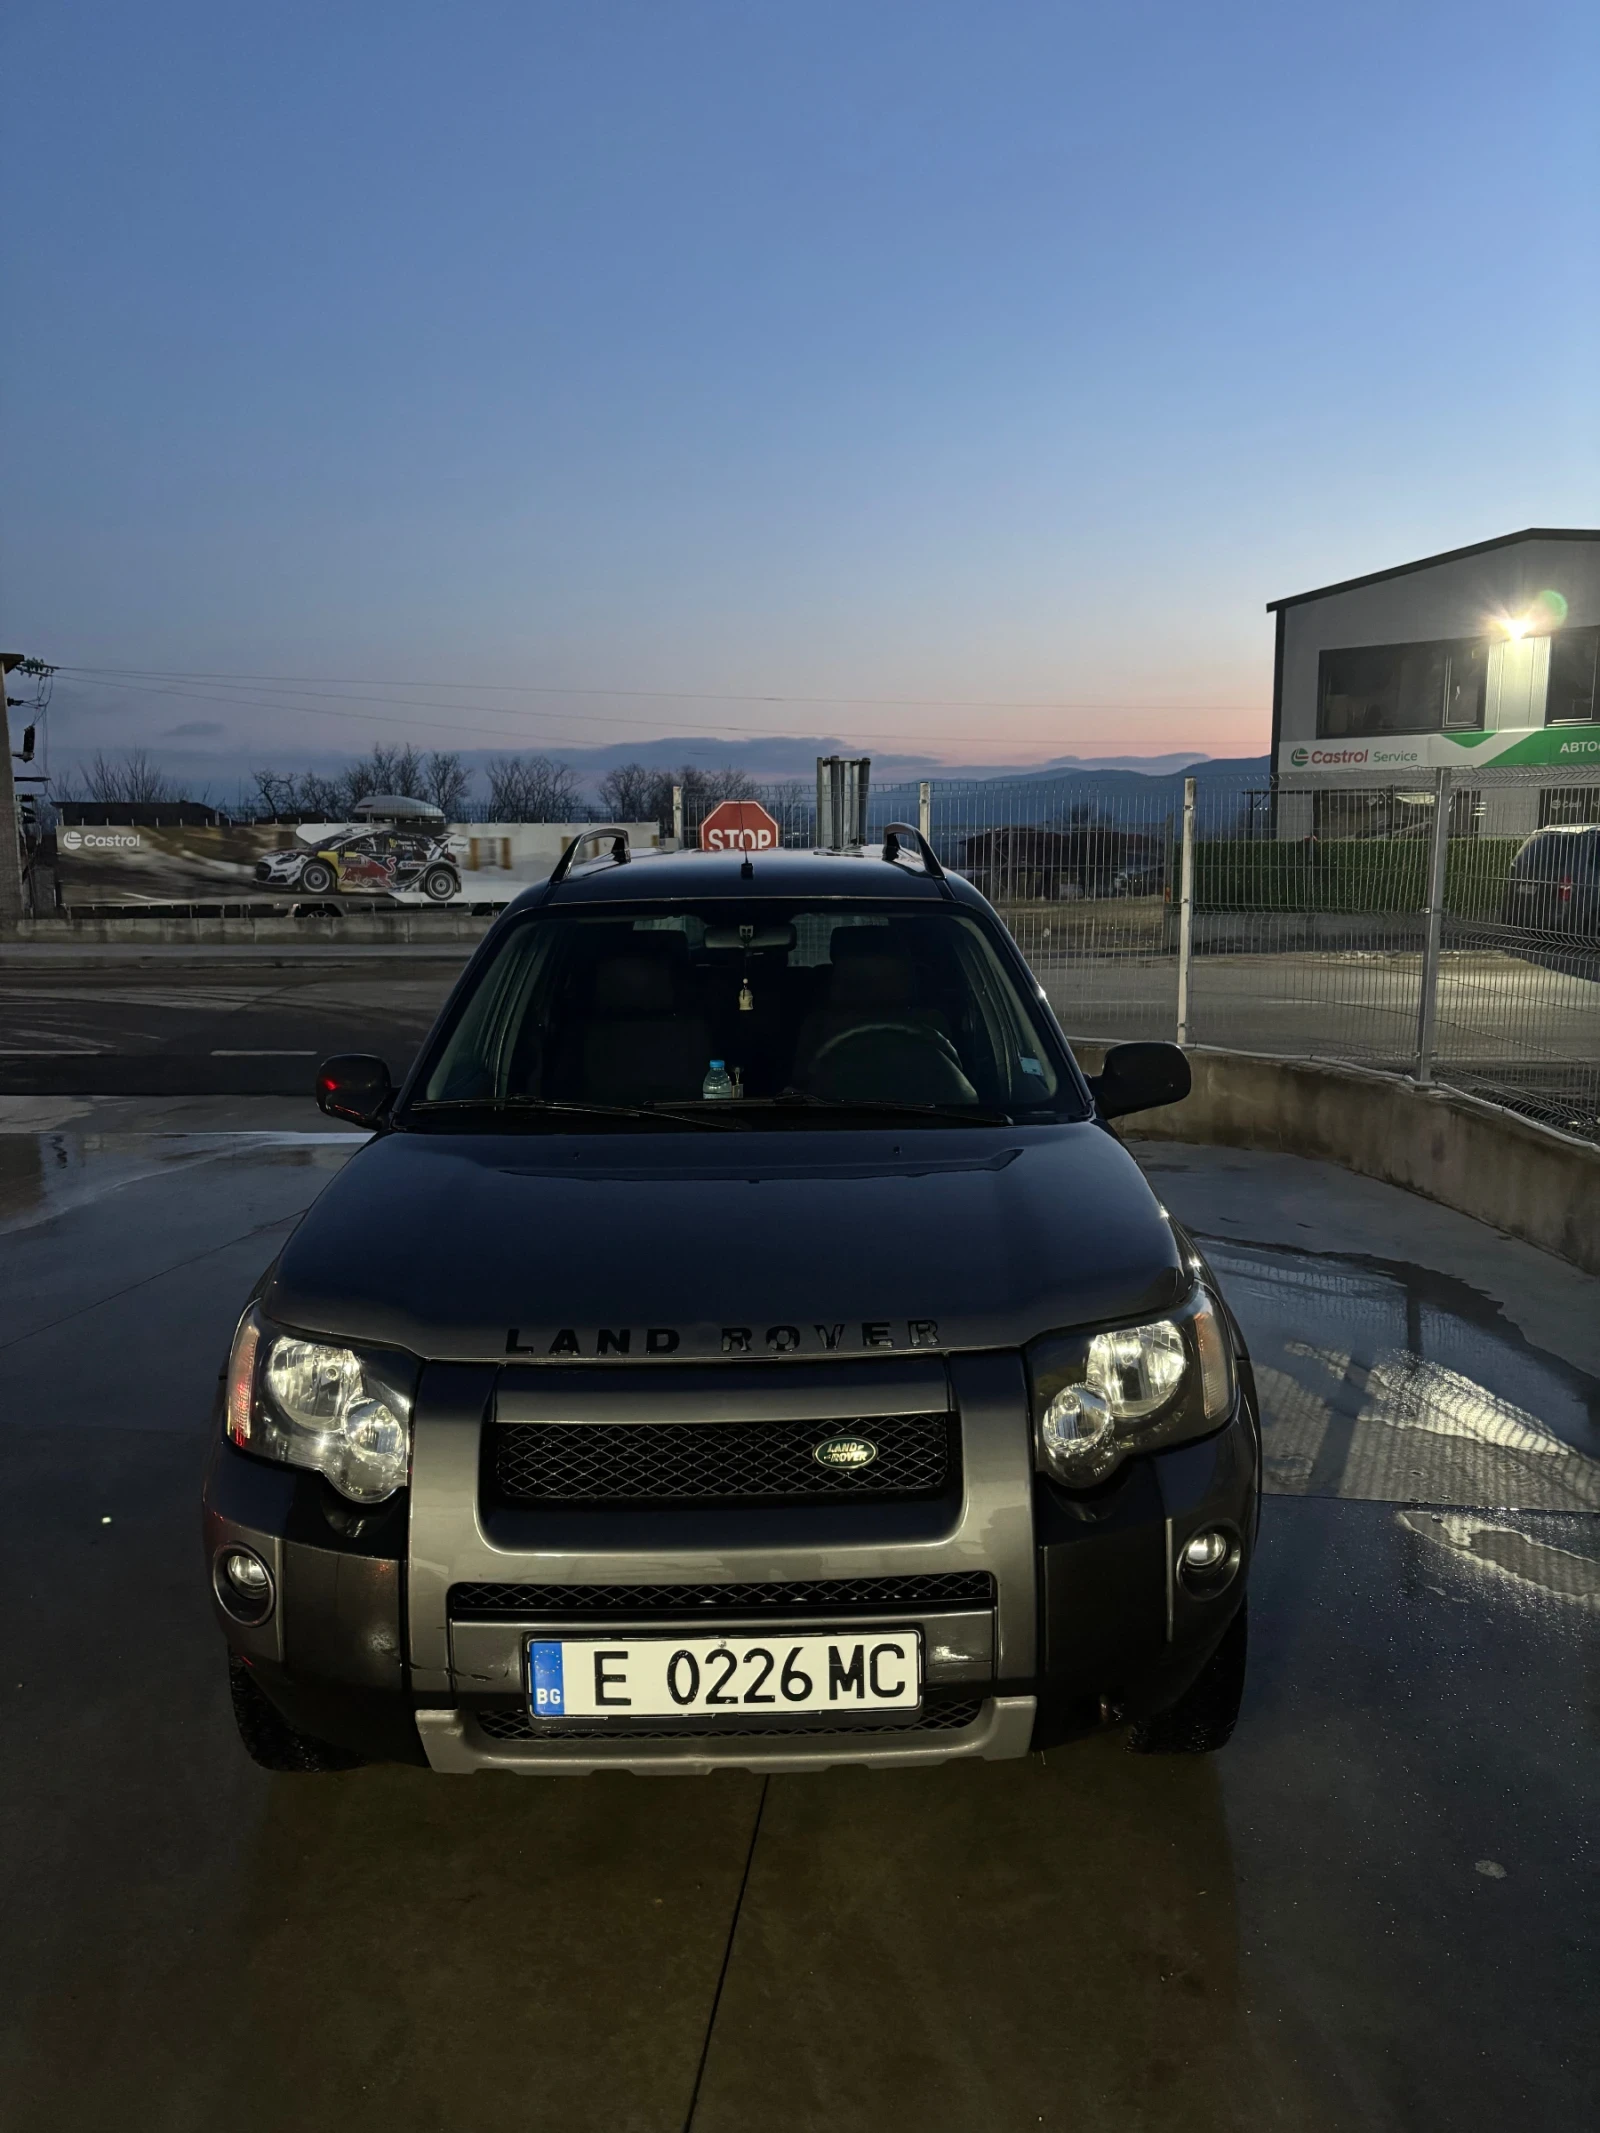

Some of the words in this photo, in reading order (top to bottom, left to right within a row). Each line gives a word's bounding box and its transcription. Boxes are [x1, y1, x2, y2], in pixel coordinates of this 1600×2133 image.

[1560, 741, 1600, 754] АВТО
[1311, 749, 1369, 764] Castrol
[1373, 751, 1418, 763] Service
[84, 834, 140, 847] Castrol
[708, 828, 771, 850] STOP
[505, 1328, 680, 1356] LAND
[721, 1319, 939, 1352] ROVER
[827, 1442, 857, 1453] LAND
[830, 1451, 868, 1462] ROVER
[593, 1650, 632, 1706] E
[666, 1646, 813, 1706] 0226
[828, 1643, 906, 1700] MC
[536, 1687, 561, 1705] BG
